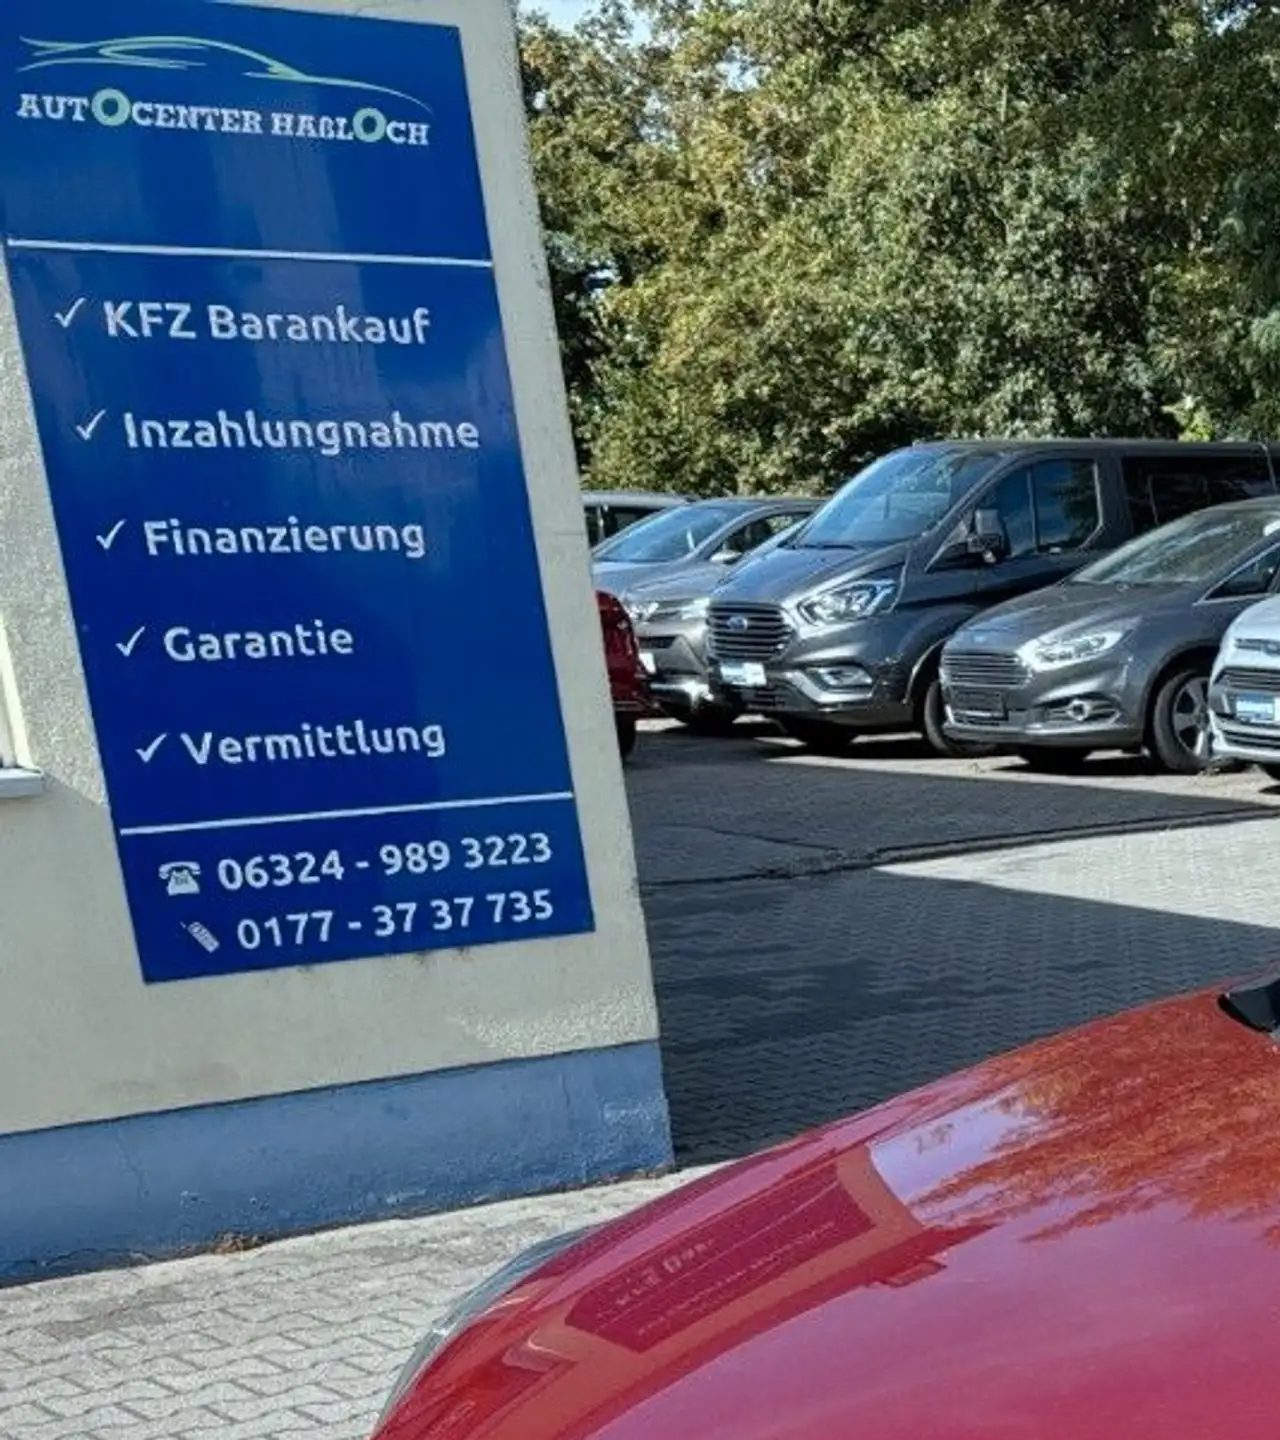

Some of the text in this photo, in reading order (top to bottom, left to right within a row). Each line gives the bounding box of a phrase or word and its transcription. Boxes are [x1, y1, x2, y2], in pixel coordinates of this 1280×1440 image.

[16, 87, 263, 134] AUTOCENTER
[103, 301, 431, 344] KFZ Barankauf
[123, 409, 480, 456] Inzahlungnahme
[143, 515, 426, 558] Finanzierung
[163, 619, 354, 662] Garantie
[180, 719, 446, 765] Vermittlung
[217, 849, 345, 891] 06324
[379, 840, 450, 876] 989
[461, 832, 552, 869] 3223
[236, 900, 334, 950] 0177
[372, 901, 418, 937] 37
[430, 896, 475, 930] 37
[486, 888, 554, 923] 735
